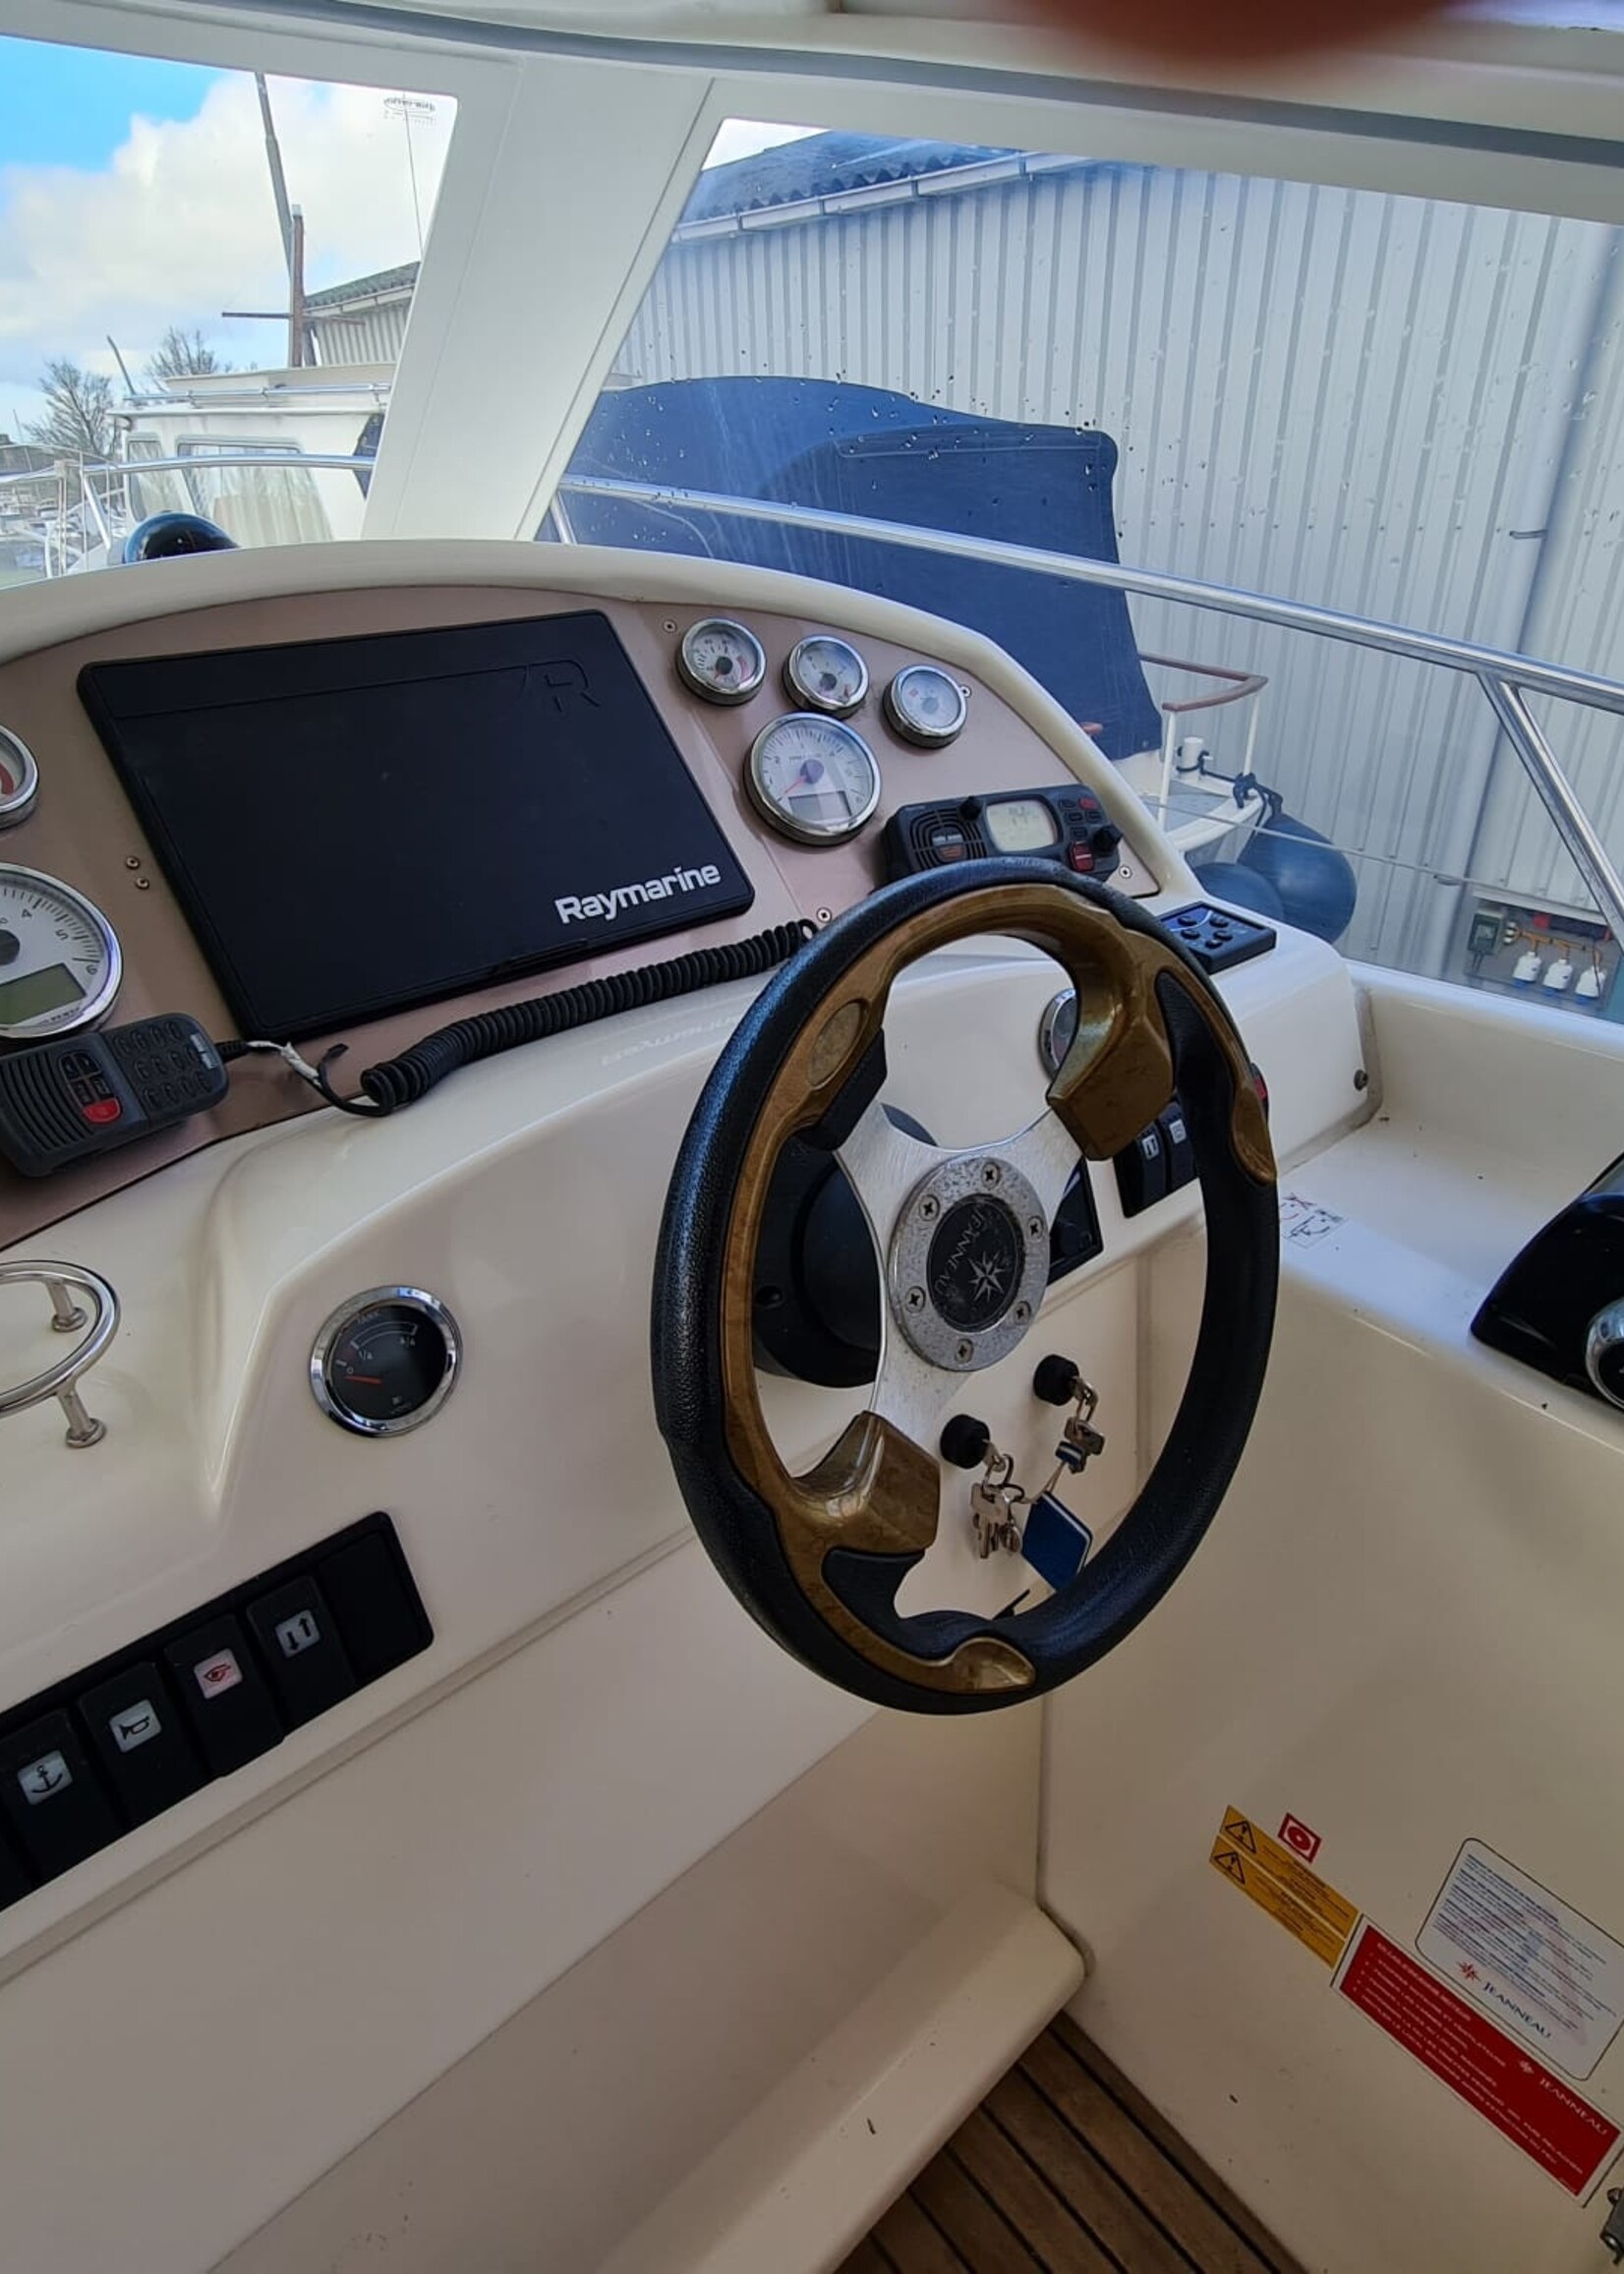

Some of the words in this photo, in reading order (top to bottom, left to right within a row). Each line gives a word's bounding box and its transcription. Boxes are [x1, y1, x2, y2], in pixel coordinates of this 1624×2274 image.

[555, 864, 721, 923] Raymarine
[22, 908, 32, 919] 4
[55, 929, 69, 941] 5
[86, 964, 98, 975] 6
[1483, 1981, 1552, 2039] JEANNEAU
[1538, 2077, 1607, 2135] JEANNEAU
